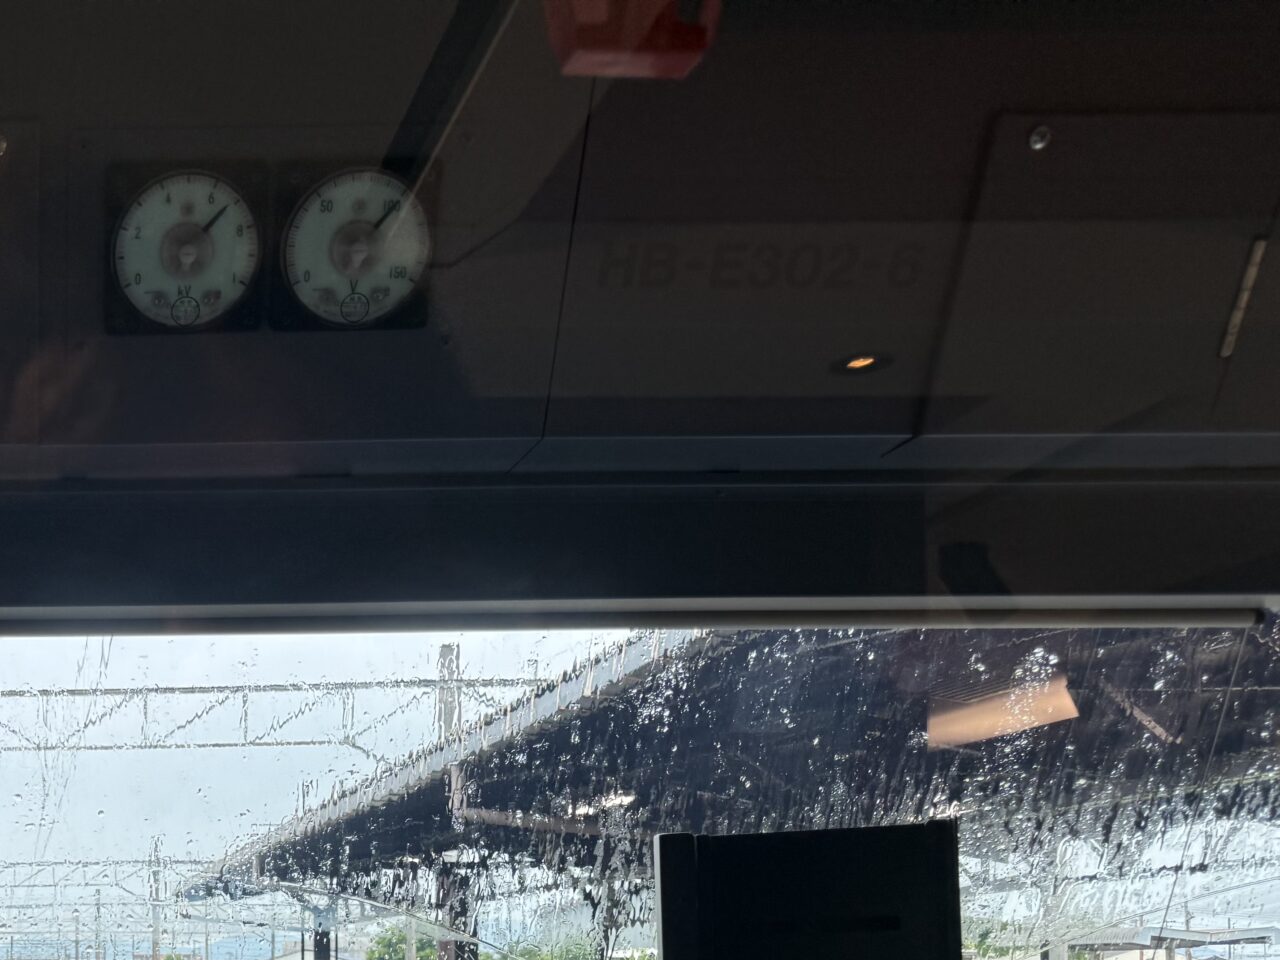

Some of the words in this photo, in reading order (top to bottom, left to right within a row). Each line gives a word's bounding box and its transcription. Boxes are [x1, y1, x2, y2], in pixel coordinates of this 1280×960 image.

[320, 201, 333, 212] 50
[597, 242, 926, 289] HB-E302-6
[389, 266, 407, 278] 150
